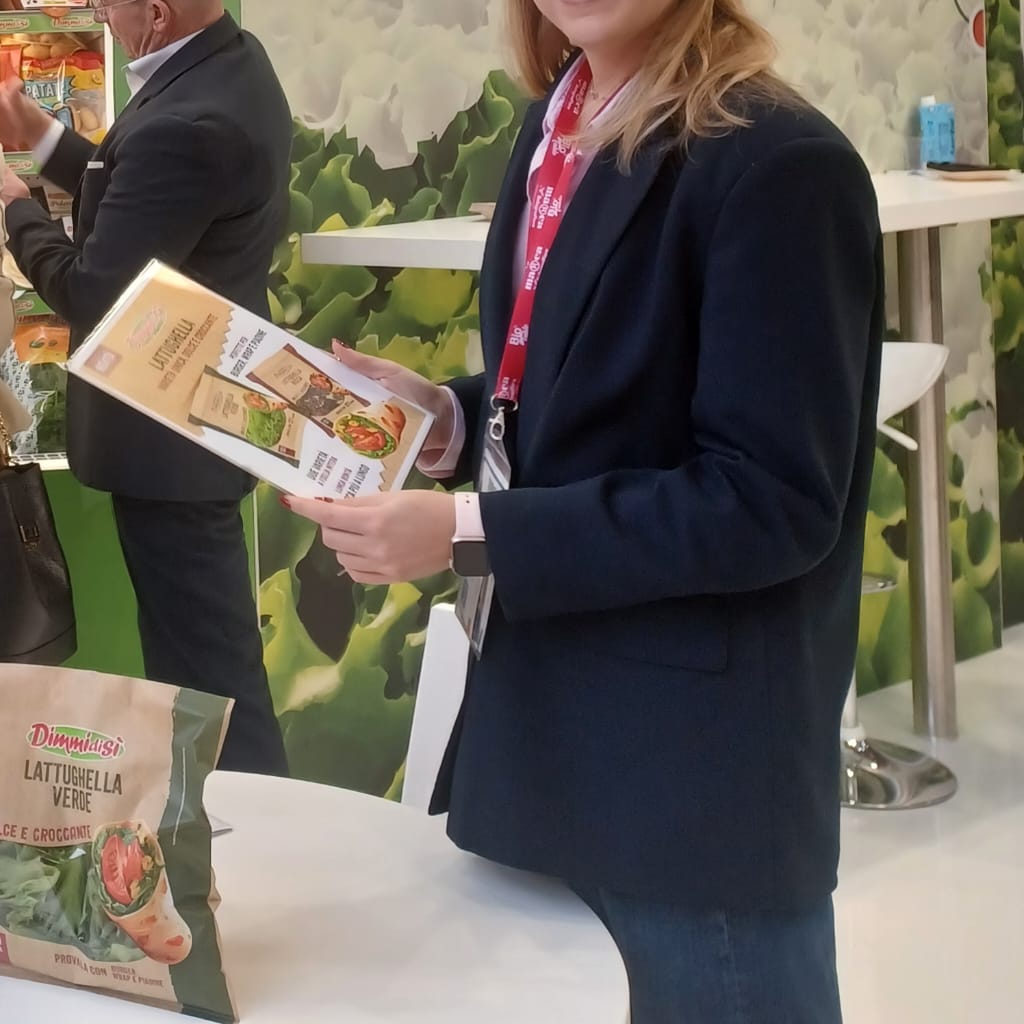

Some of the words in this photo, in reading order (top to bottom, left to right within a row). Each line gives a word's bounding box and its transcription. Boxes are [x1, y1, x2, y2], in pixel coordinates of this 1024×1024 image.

[148, 318, 196, 371] LATTUGHELLA
[24, 759, 123, 795] LATTUGHELLA
[53, 786, 92, 813] VERDE
[21, 827, 28, 840] E
[33, 825, 91, 842] CROCCANTE
[90, 966, 107, 977] CON
